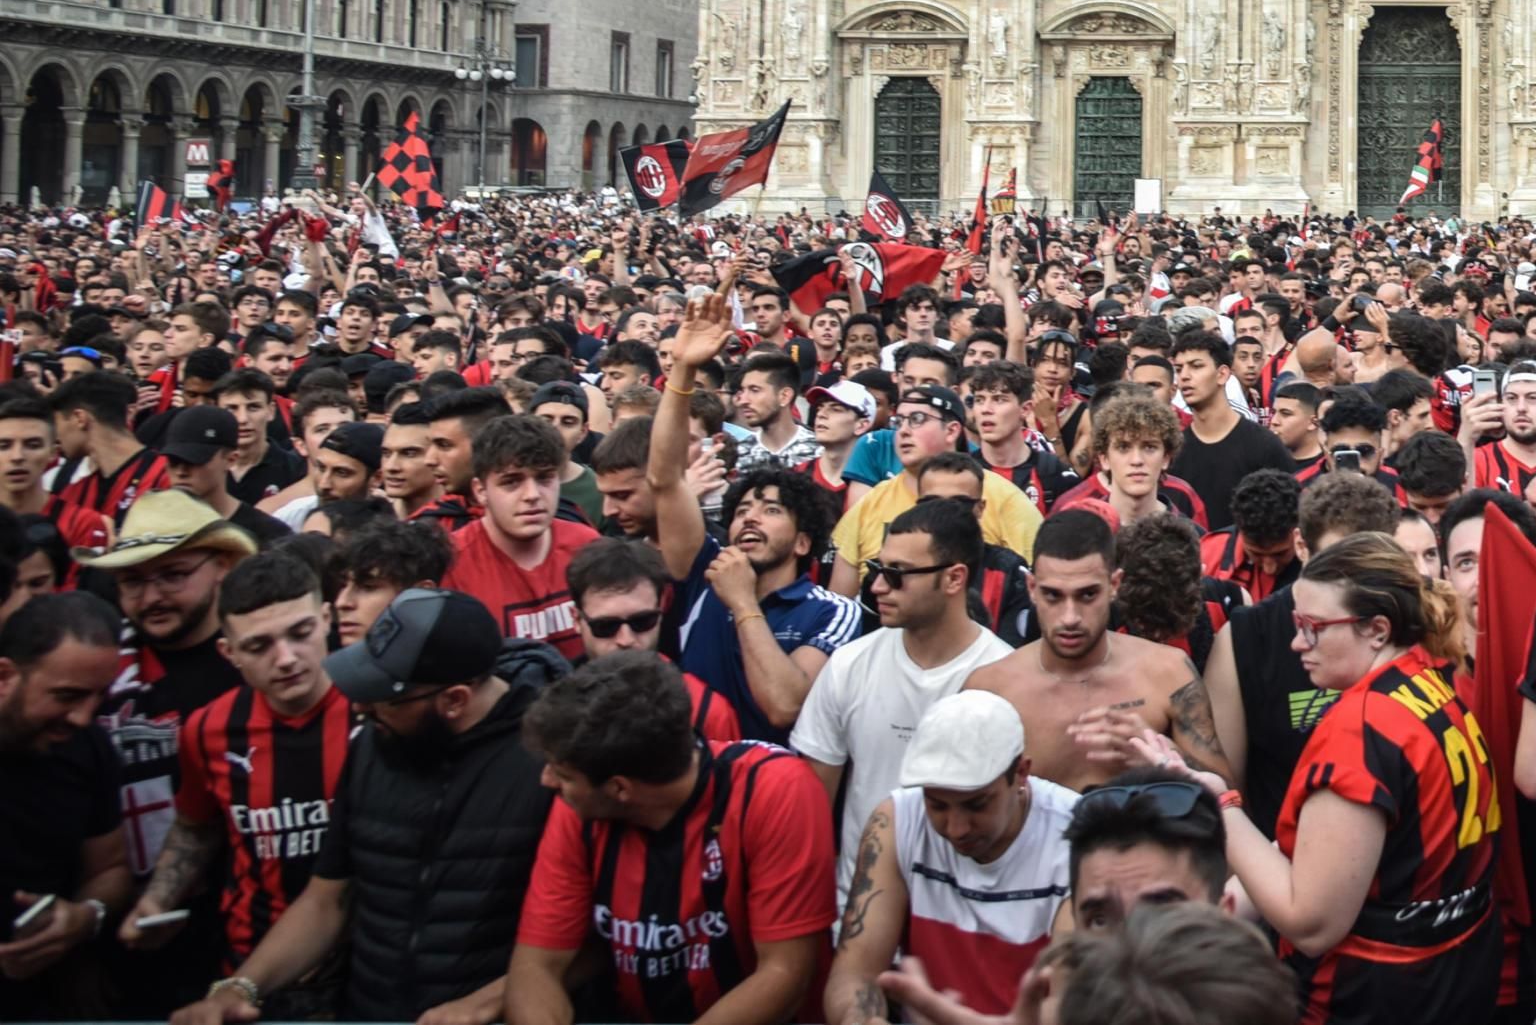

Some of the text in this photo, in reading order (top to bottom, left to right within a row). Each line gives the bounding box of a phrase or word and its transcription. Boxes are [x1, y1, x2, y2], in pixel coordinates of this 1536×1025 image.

[187, 144, 209, 162] M
[230, 797, 334, 833] Emira
[594, 904, 728, 950] Emirates
[615, 943, 710, 978] FLY BETTER
